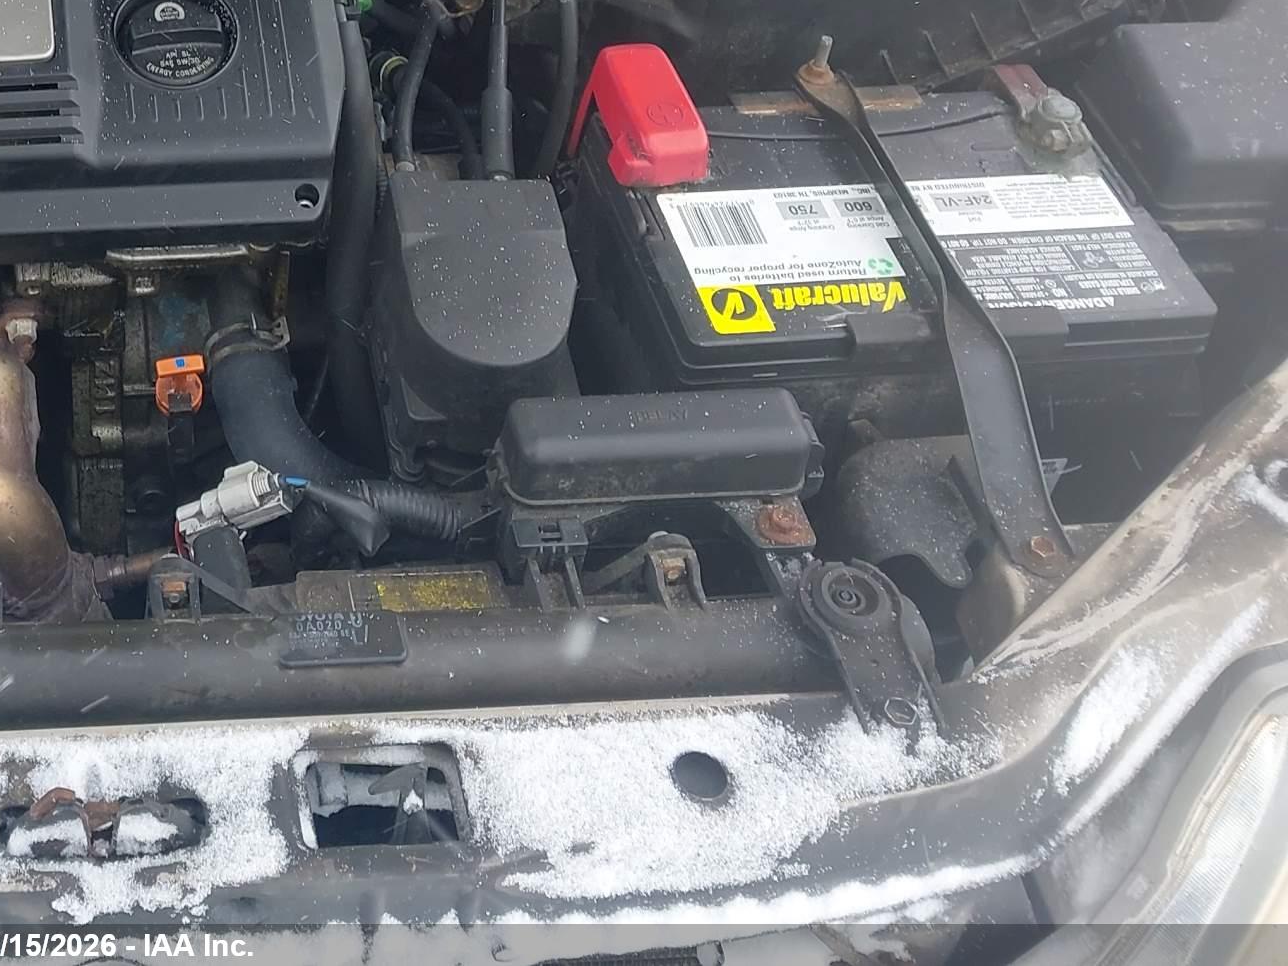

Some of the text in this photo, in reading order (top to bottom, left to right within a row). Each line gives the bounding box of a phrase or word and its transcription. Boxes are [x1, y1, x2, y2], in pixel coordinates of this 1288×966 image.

[147, 62, 172, 77] ENERGY
[844, 201, 872, 212] 600
[936, 195, 992, 207] 24F-VL
[789, 204, 818, 215] 750
[695, 259, 861, 276] AutoZone for proper recycling
[828, 268, 866, 276] Return
[744, 272, 794, 282] batteries
[798, 271, 824, 279] used
[772, 281, 906, 312] Valucraft
